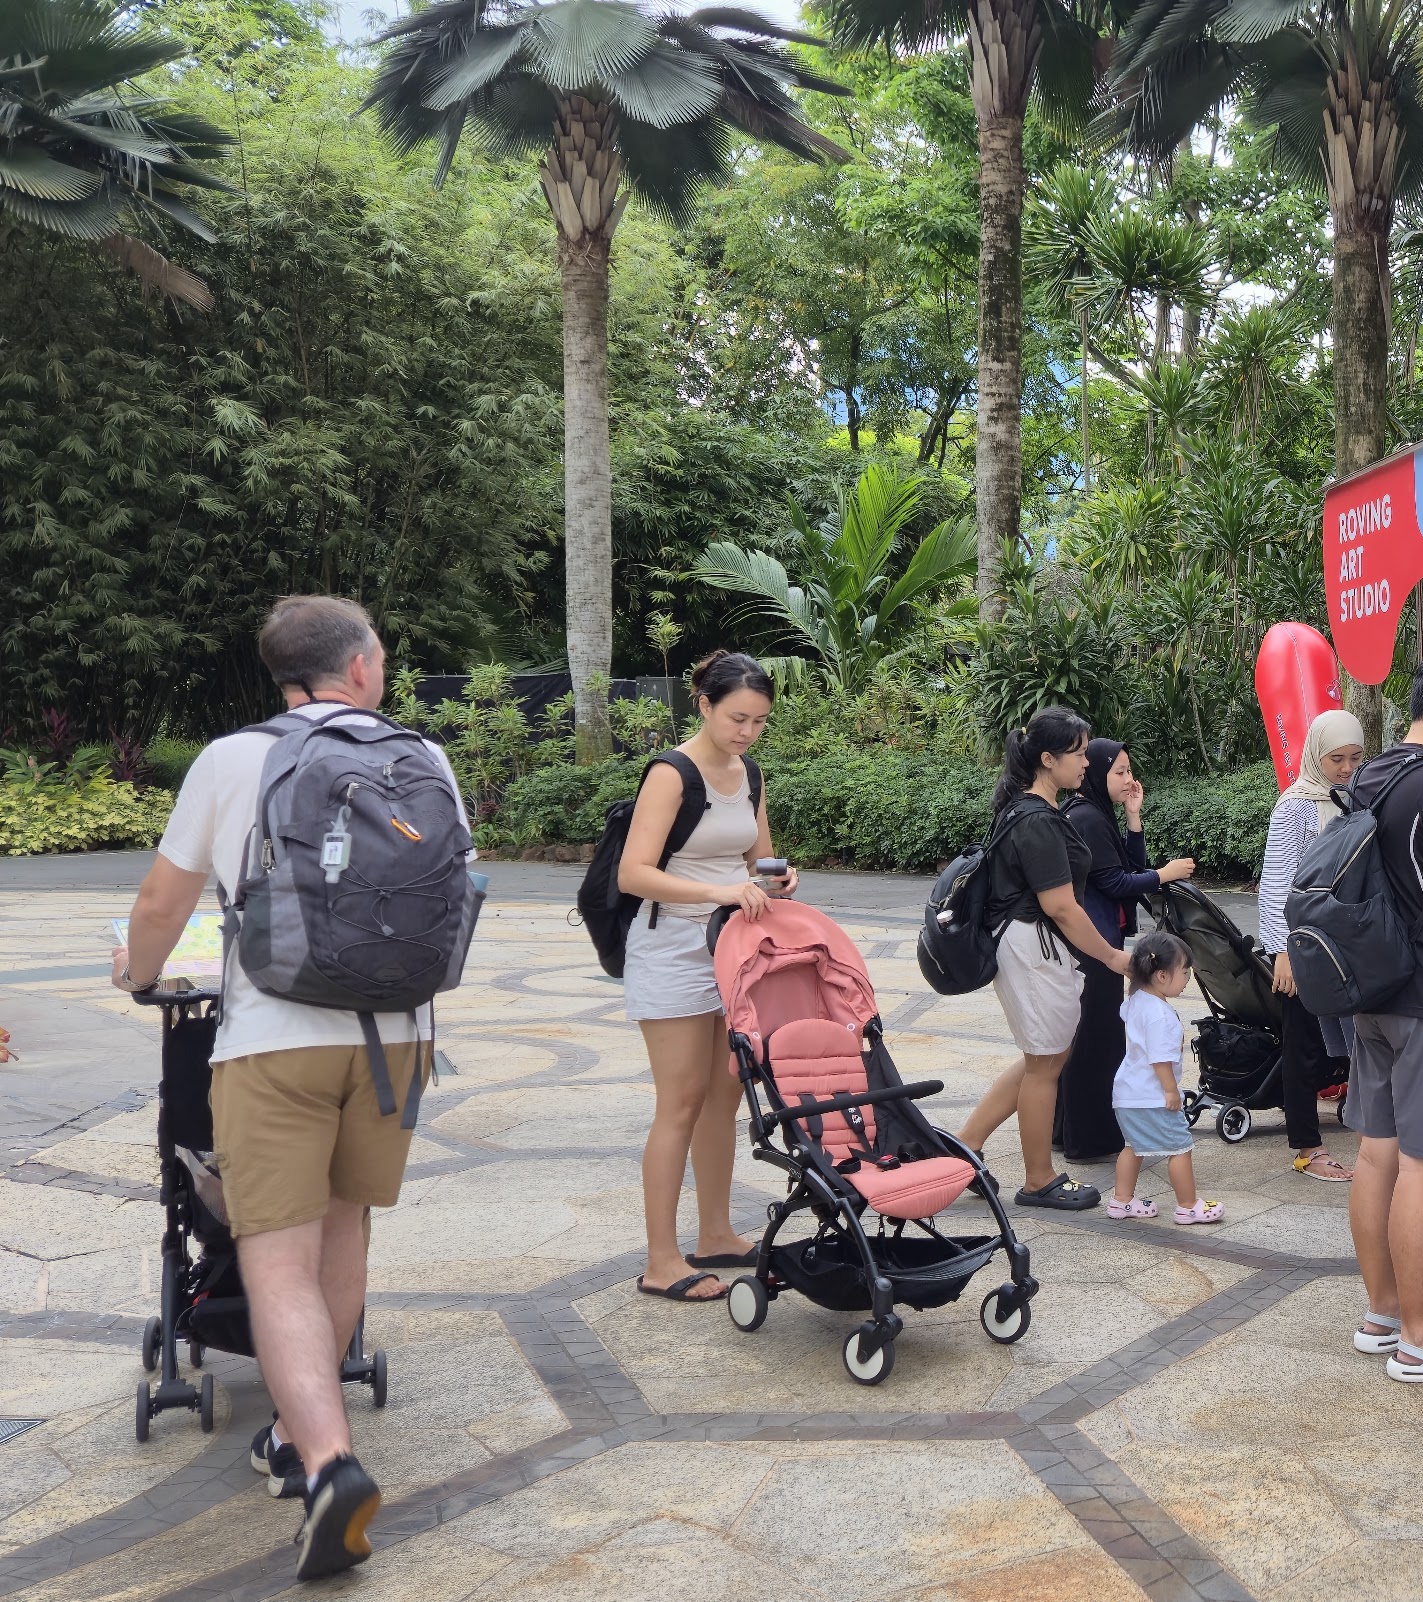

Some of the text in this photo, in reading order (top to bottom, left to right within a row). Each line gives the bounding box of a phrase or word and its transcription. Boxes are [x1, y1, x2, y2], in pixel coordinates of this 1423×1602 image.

[1339, 494, 1392, 543] ROVING
[1340, 546, 1364, 583] ART
[1340, 579, 1390, 622] STUDIO
